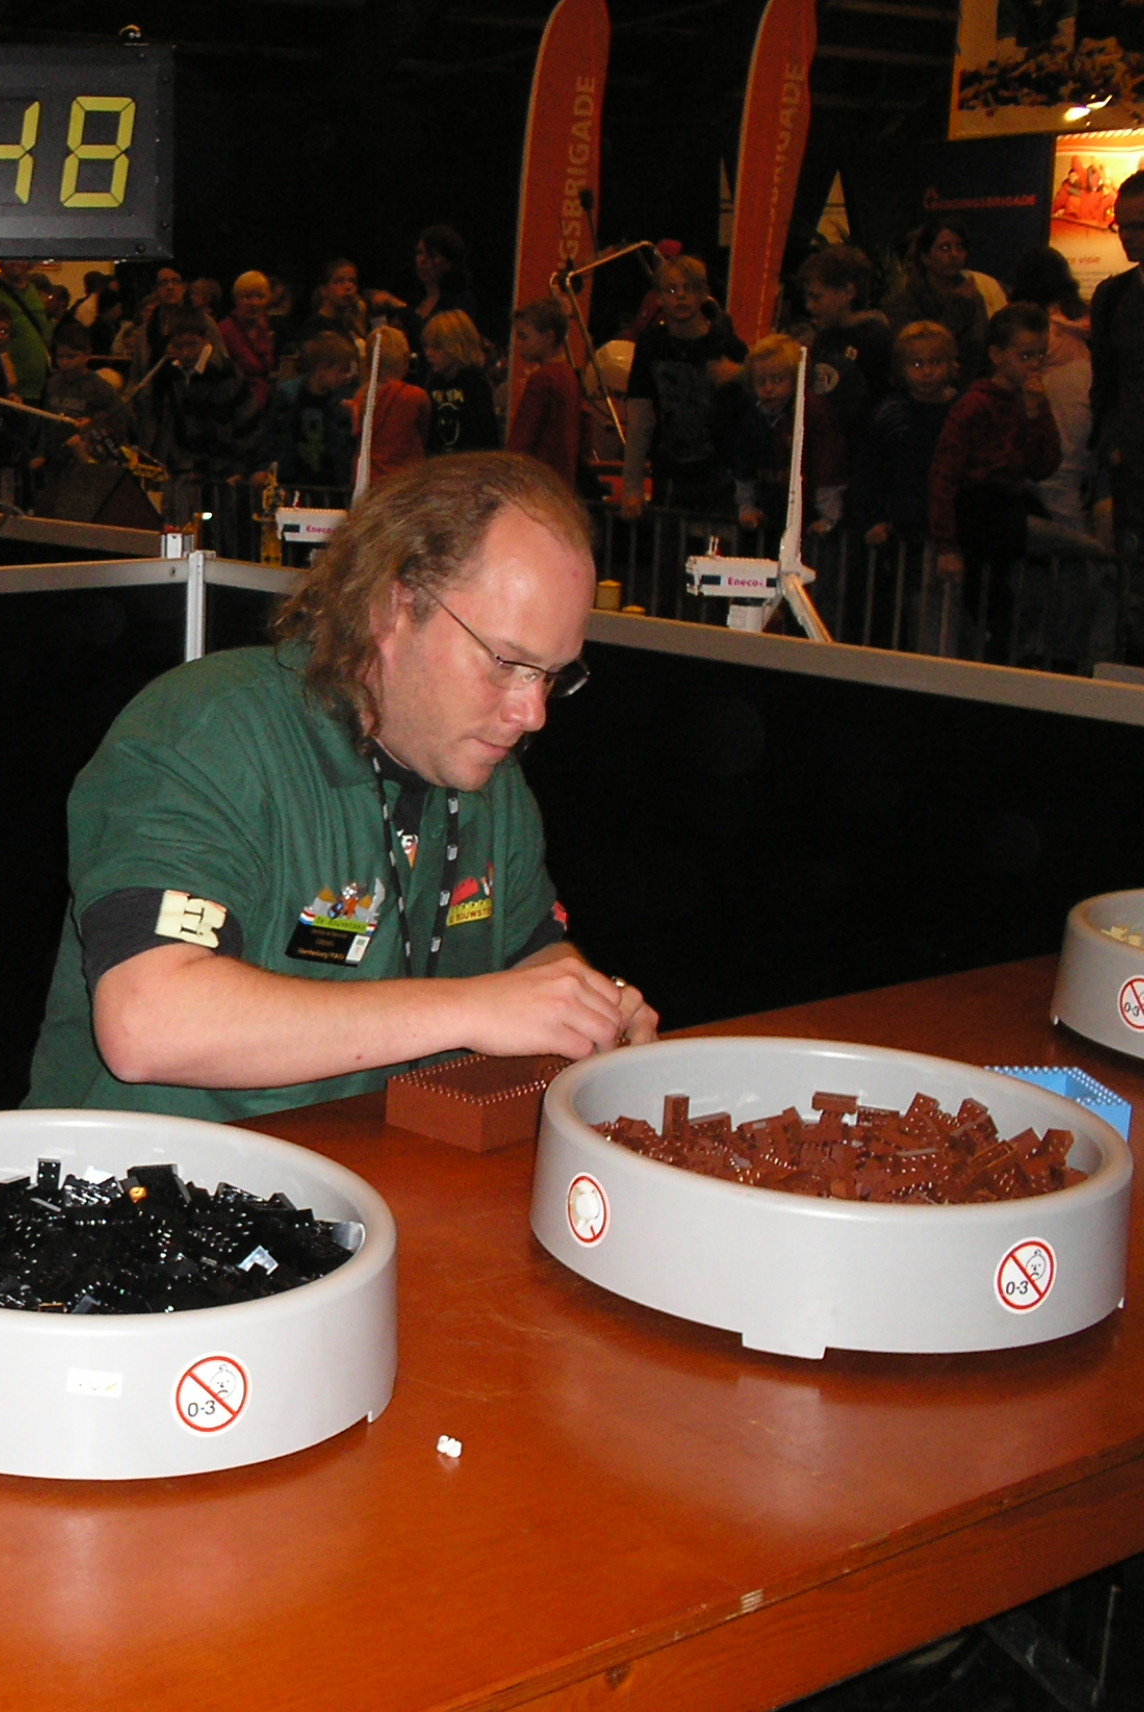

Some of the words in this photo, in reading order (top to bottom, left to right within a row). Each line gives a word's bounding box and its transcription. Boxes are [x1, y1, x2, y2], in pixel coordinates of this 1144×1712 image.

[556, 75, 596, 270] GSBRIGADE
[1005, 1280, 1029, 1296] 0-3
[187, 1400, 216, 1418] 0-3
